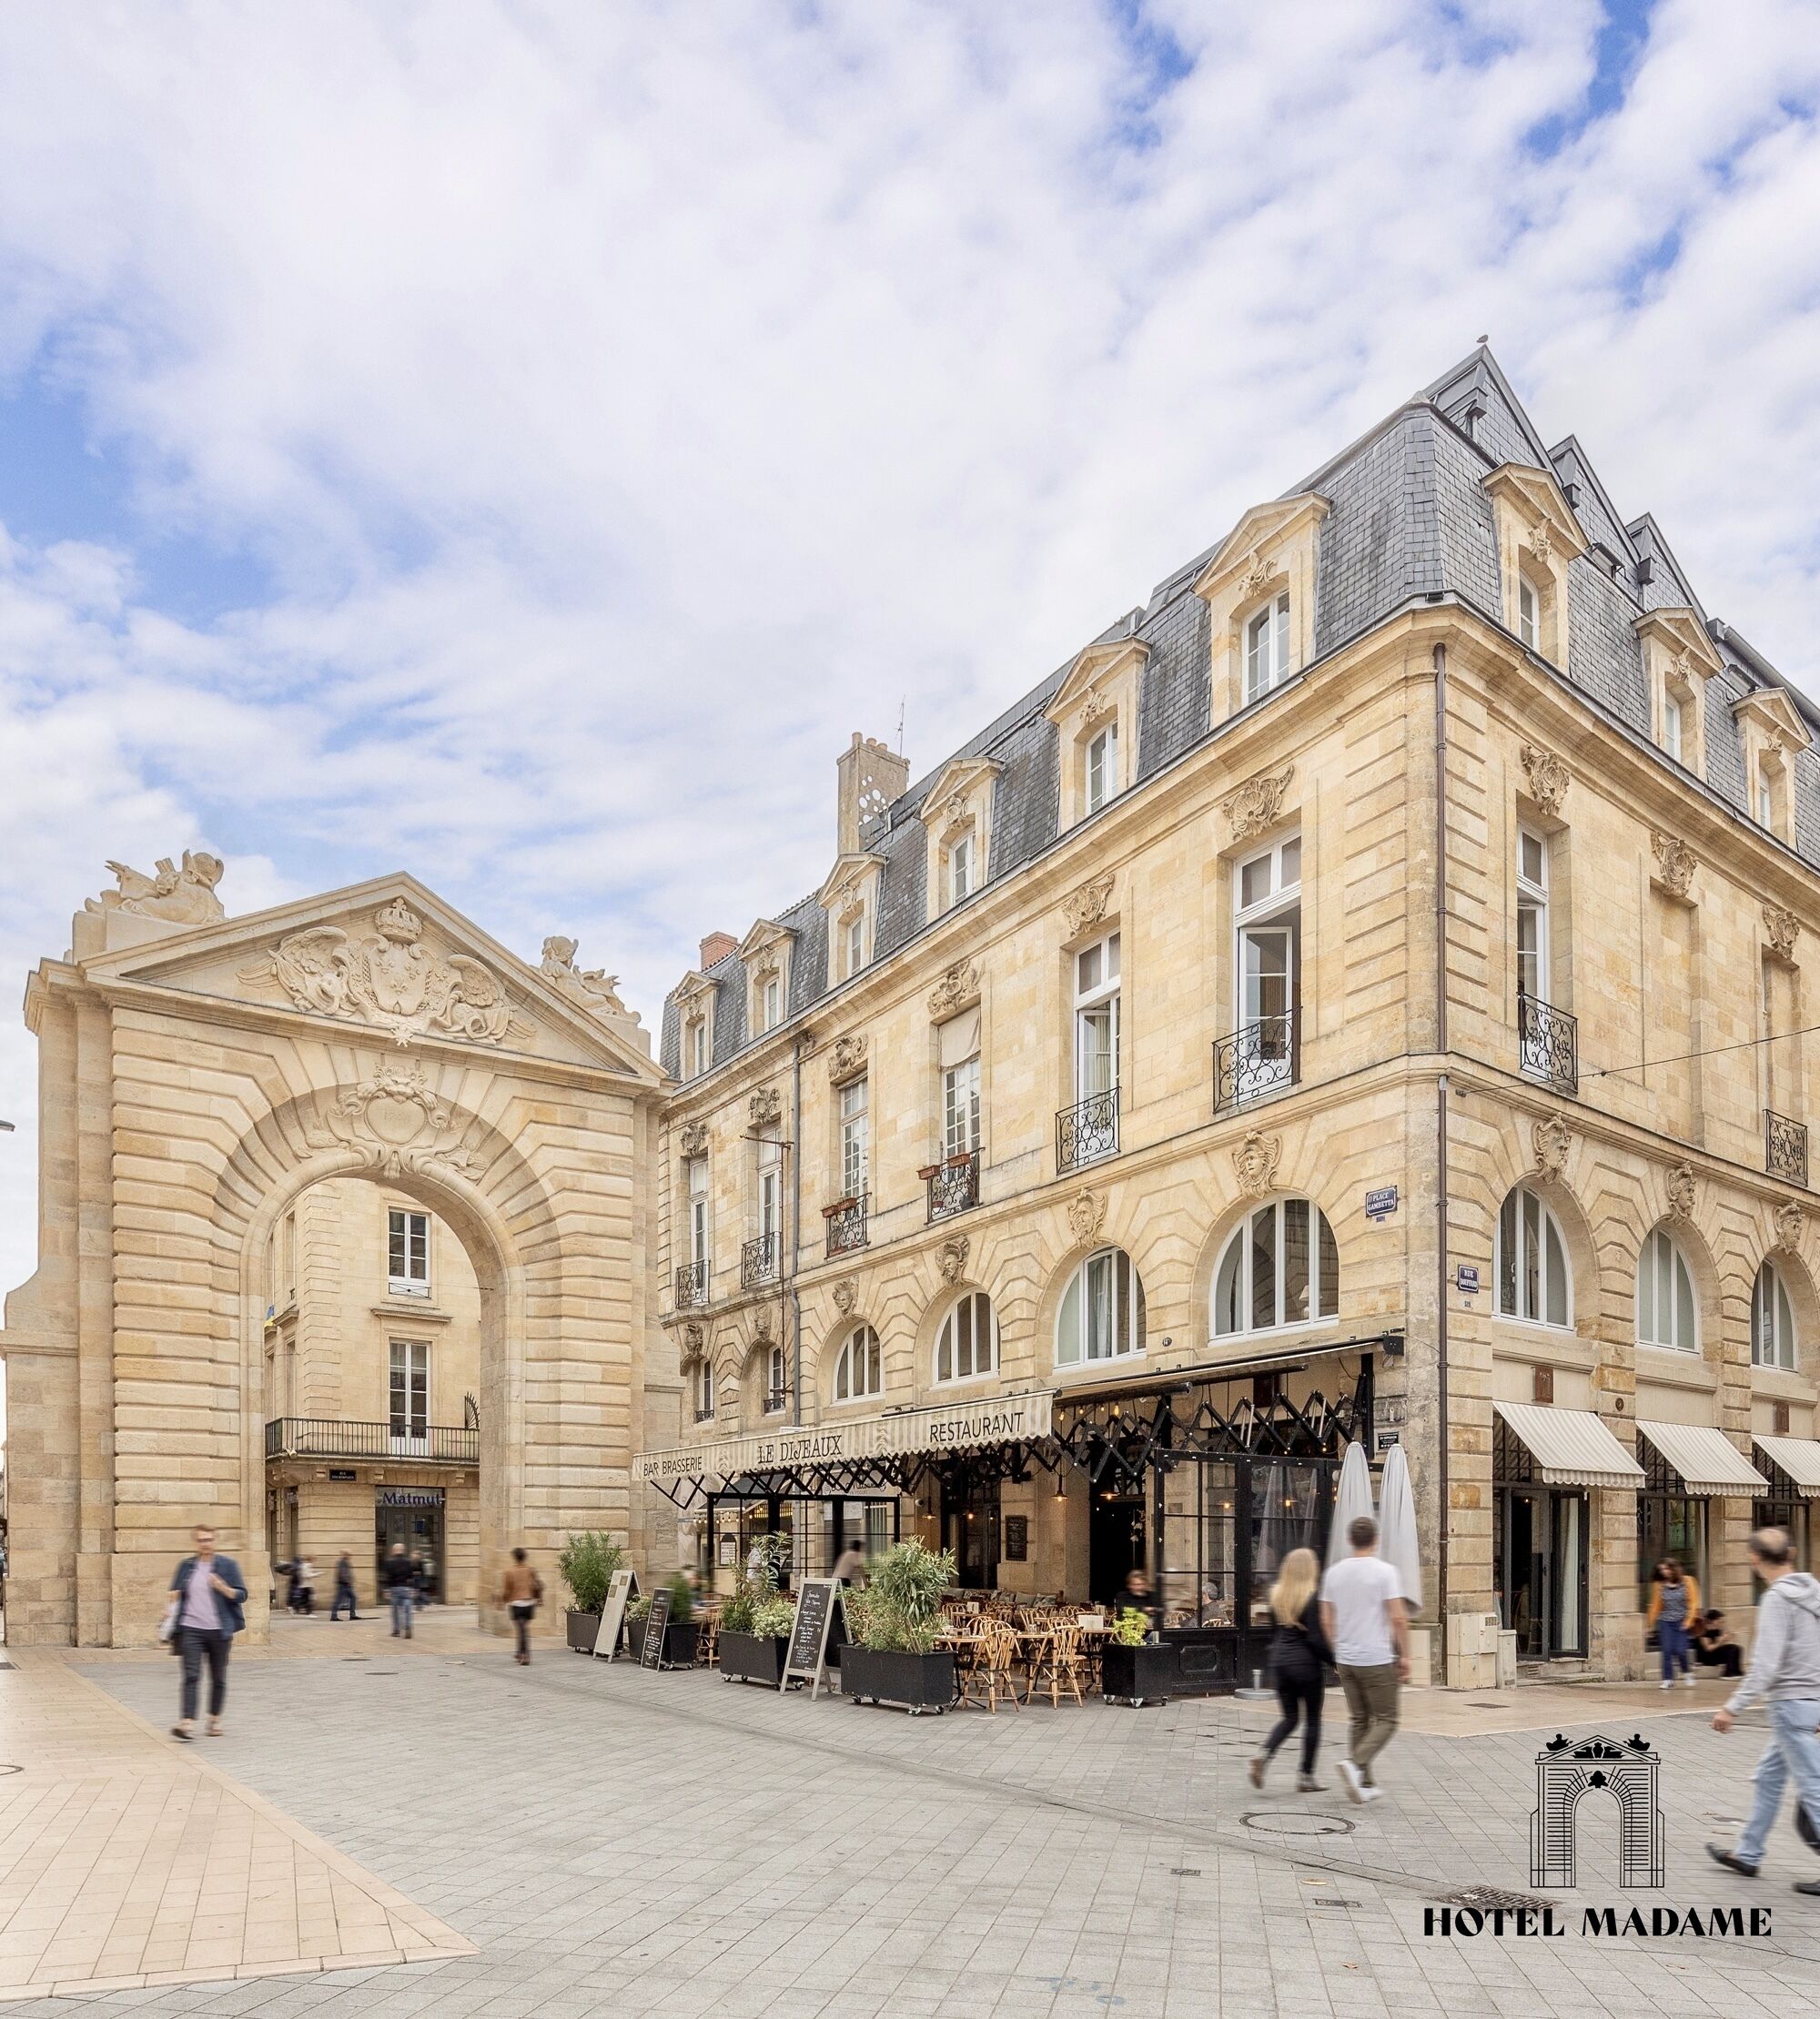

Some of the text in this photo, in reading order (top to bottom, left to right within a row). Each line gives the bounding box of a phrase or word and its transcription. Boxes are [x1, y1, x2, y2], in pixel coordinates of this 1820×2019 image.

[1372, 1192, 1389, 1201] PLACE
[1368, 1199, 1394, 1211] GAMBETTA
[1463, 1269, 1474, 1278] RUE
[929, 1411, 1025, 1443] RESTAURANT
[758, 1435, 843, 1464] LE DIJEAUX
[643, 1456, 703, 1477] BAR BRASSERIE
[383, 1491, 441, 1506] Matmut
